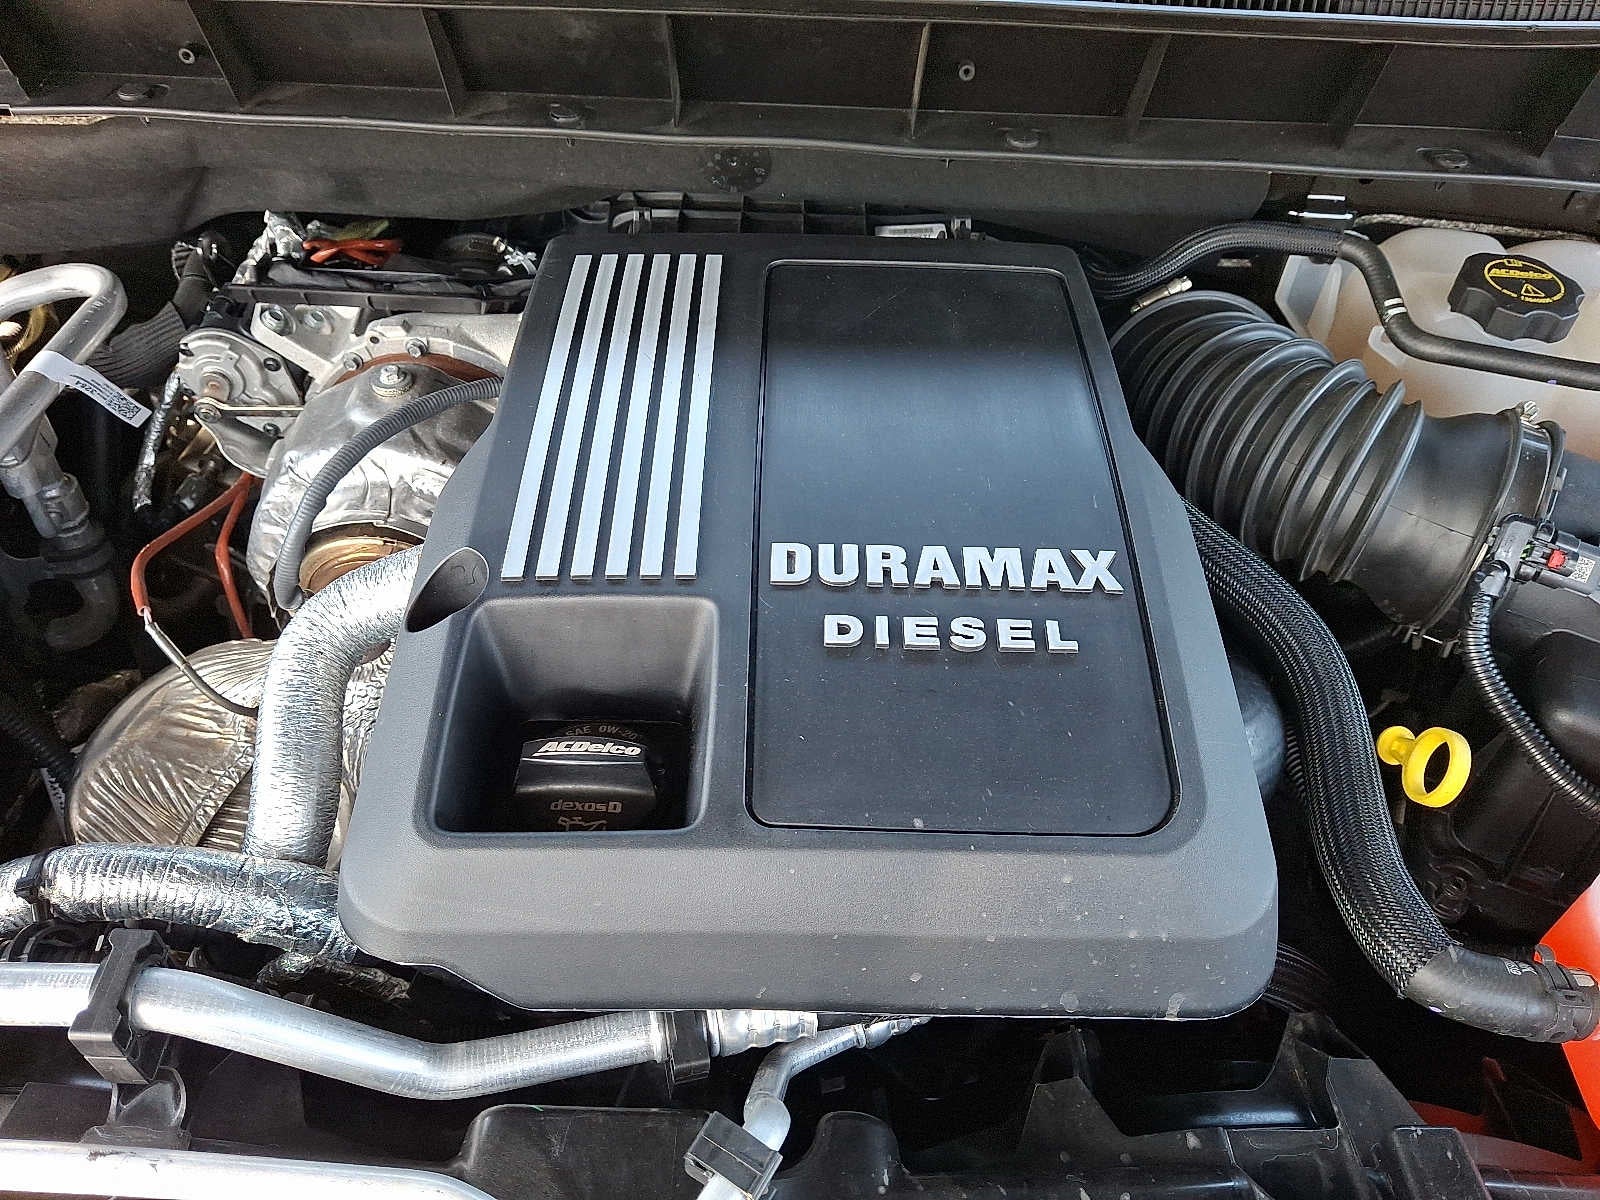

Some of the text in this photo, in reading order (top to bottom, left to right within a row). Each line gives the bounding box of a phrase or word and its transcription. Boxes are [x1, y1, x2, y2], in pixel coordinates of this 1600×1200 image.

[769, 542, 1124, 594] DURAMAX
[823, 614, 1079, 653] DIESEL
[566, 724, 638, 740] SAE 0W-20
[535, 741, 642, 756] ACDelco
[550, 799, 622, 814] dexosD
